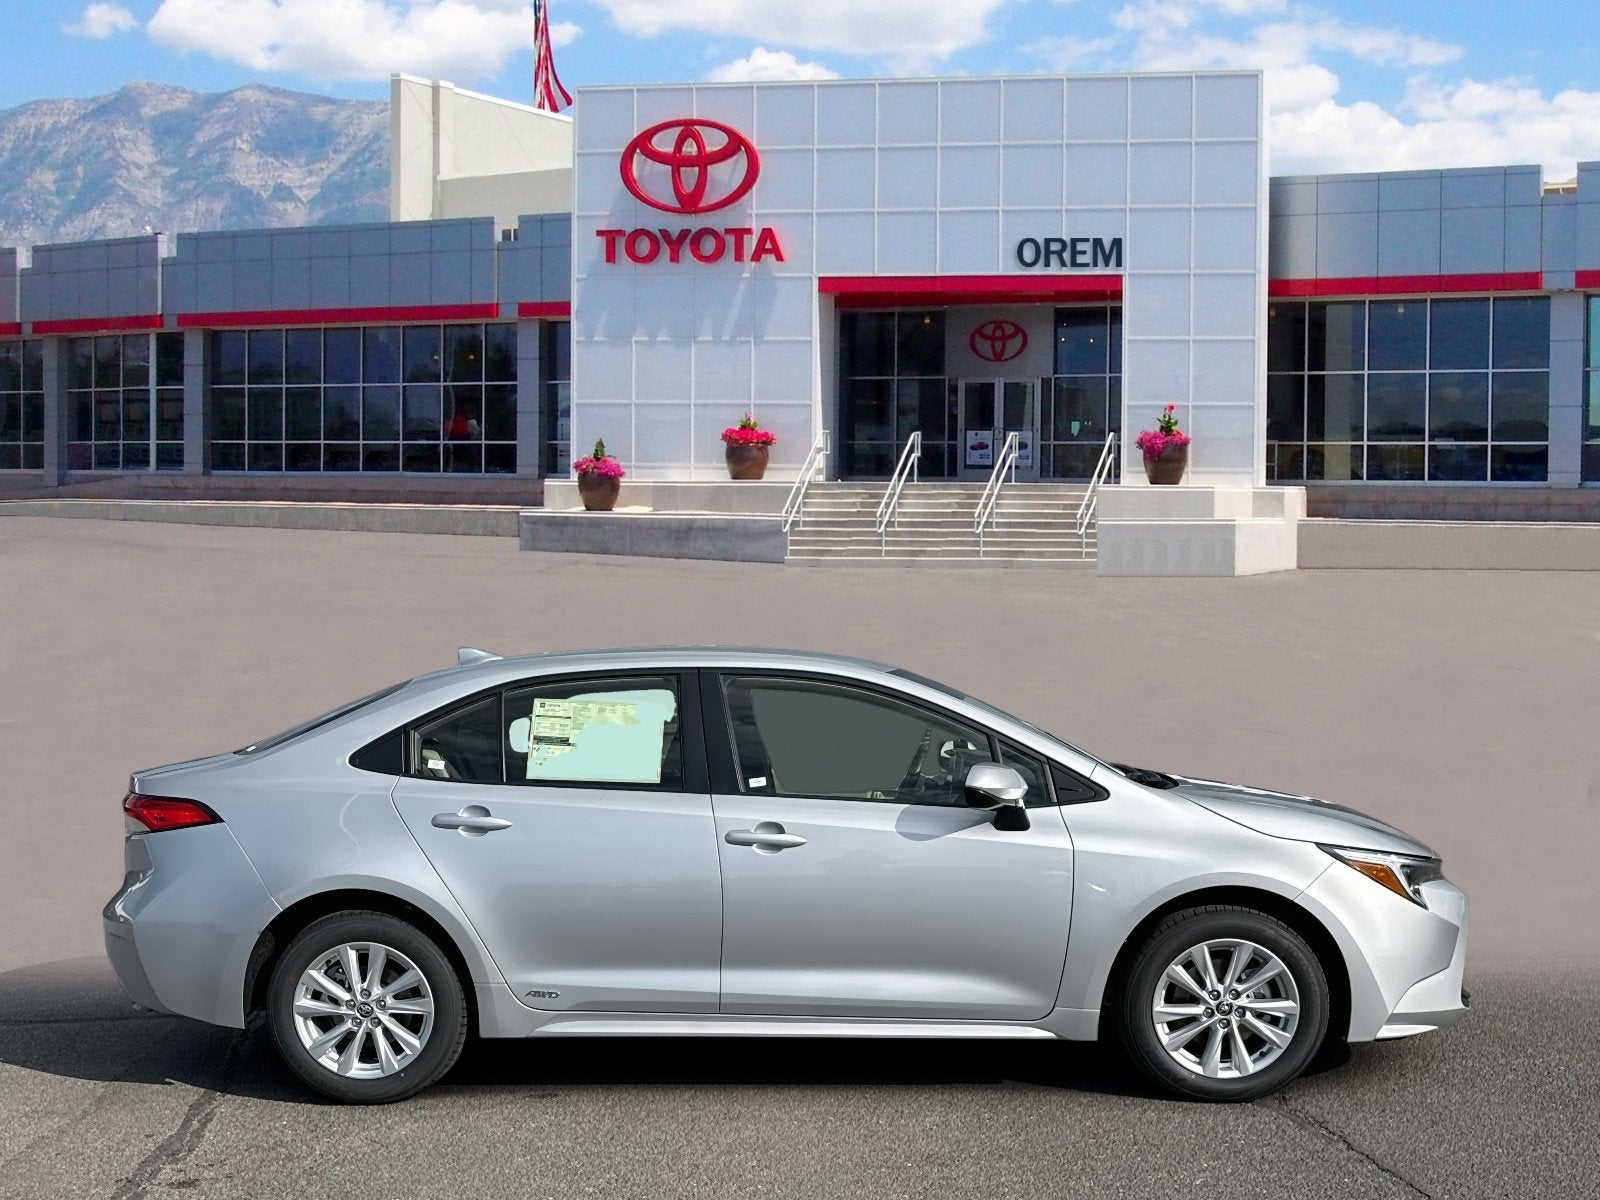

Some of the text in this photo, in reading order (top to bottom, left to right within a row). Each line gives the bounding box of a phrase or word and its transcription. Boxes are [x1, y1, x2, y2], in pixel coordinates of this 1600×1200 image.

[595, 227, 785, 264] TOYOTA
[1016, 237, 1123, 268] OREM
[524, 990, 560, 999] AWD
